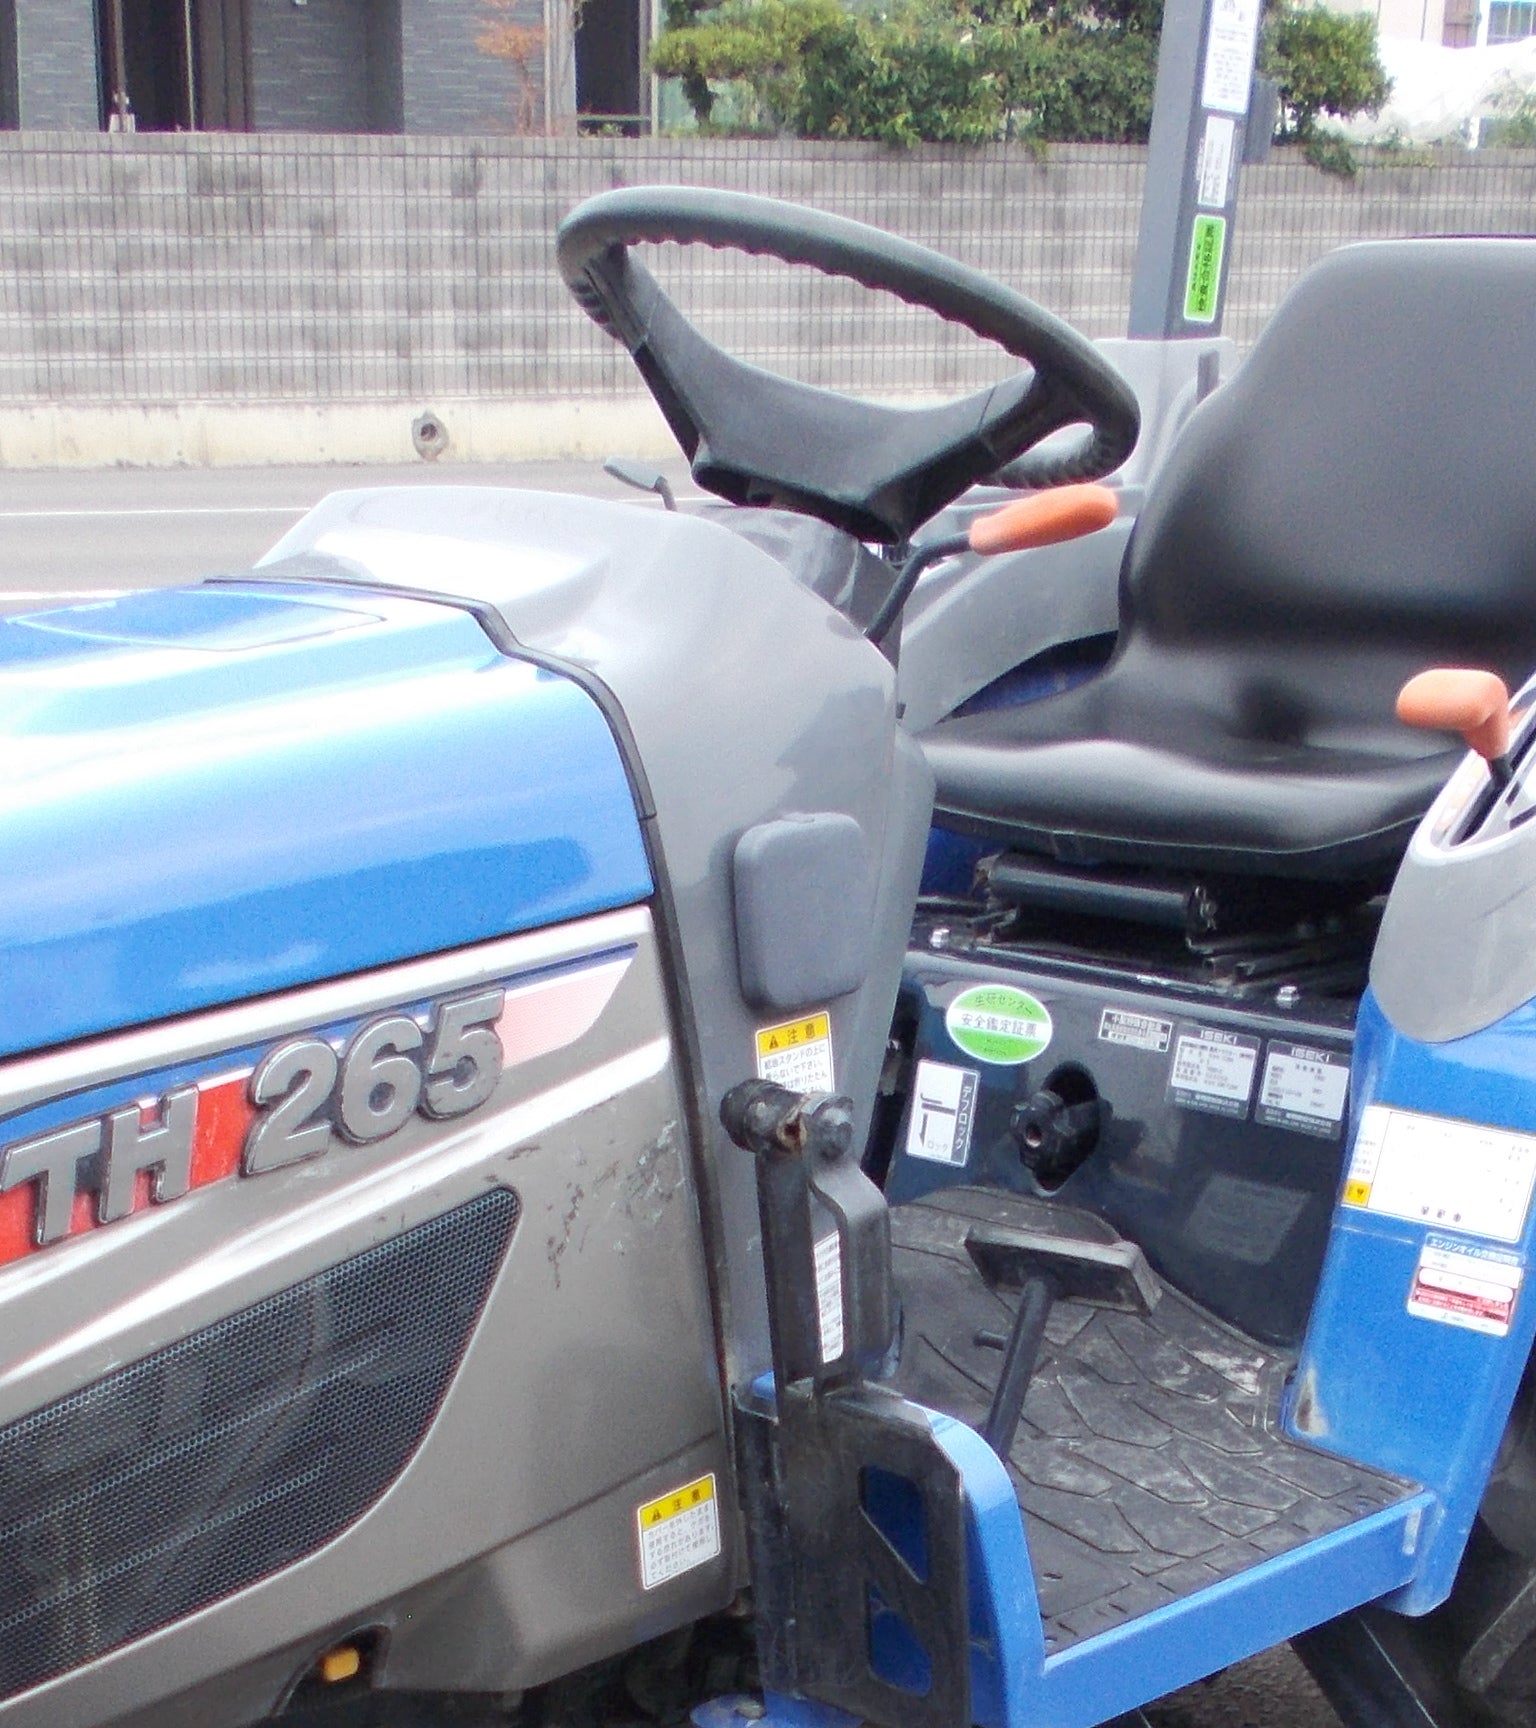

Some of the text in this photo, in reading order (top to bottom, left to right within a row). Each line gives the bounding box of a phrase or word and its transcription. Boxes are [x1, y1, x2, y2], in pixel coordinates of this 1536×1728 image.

[1200, 1029, 1238, 1045] ISEKI
[1291, 1046, 1330, 1063] ISEKI
[240, 987, 506, 1178] 265
